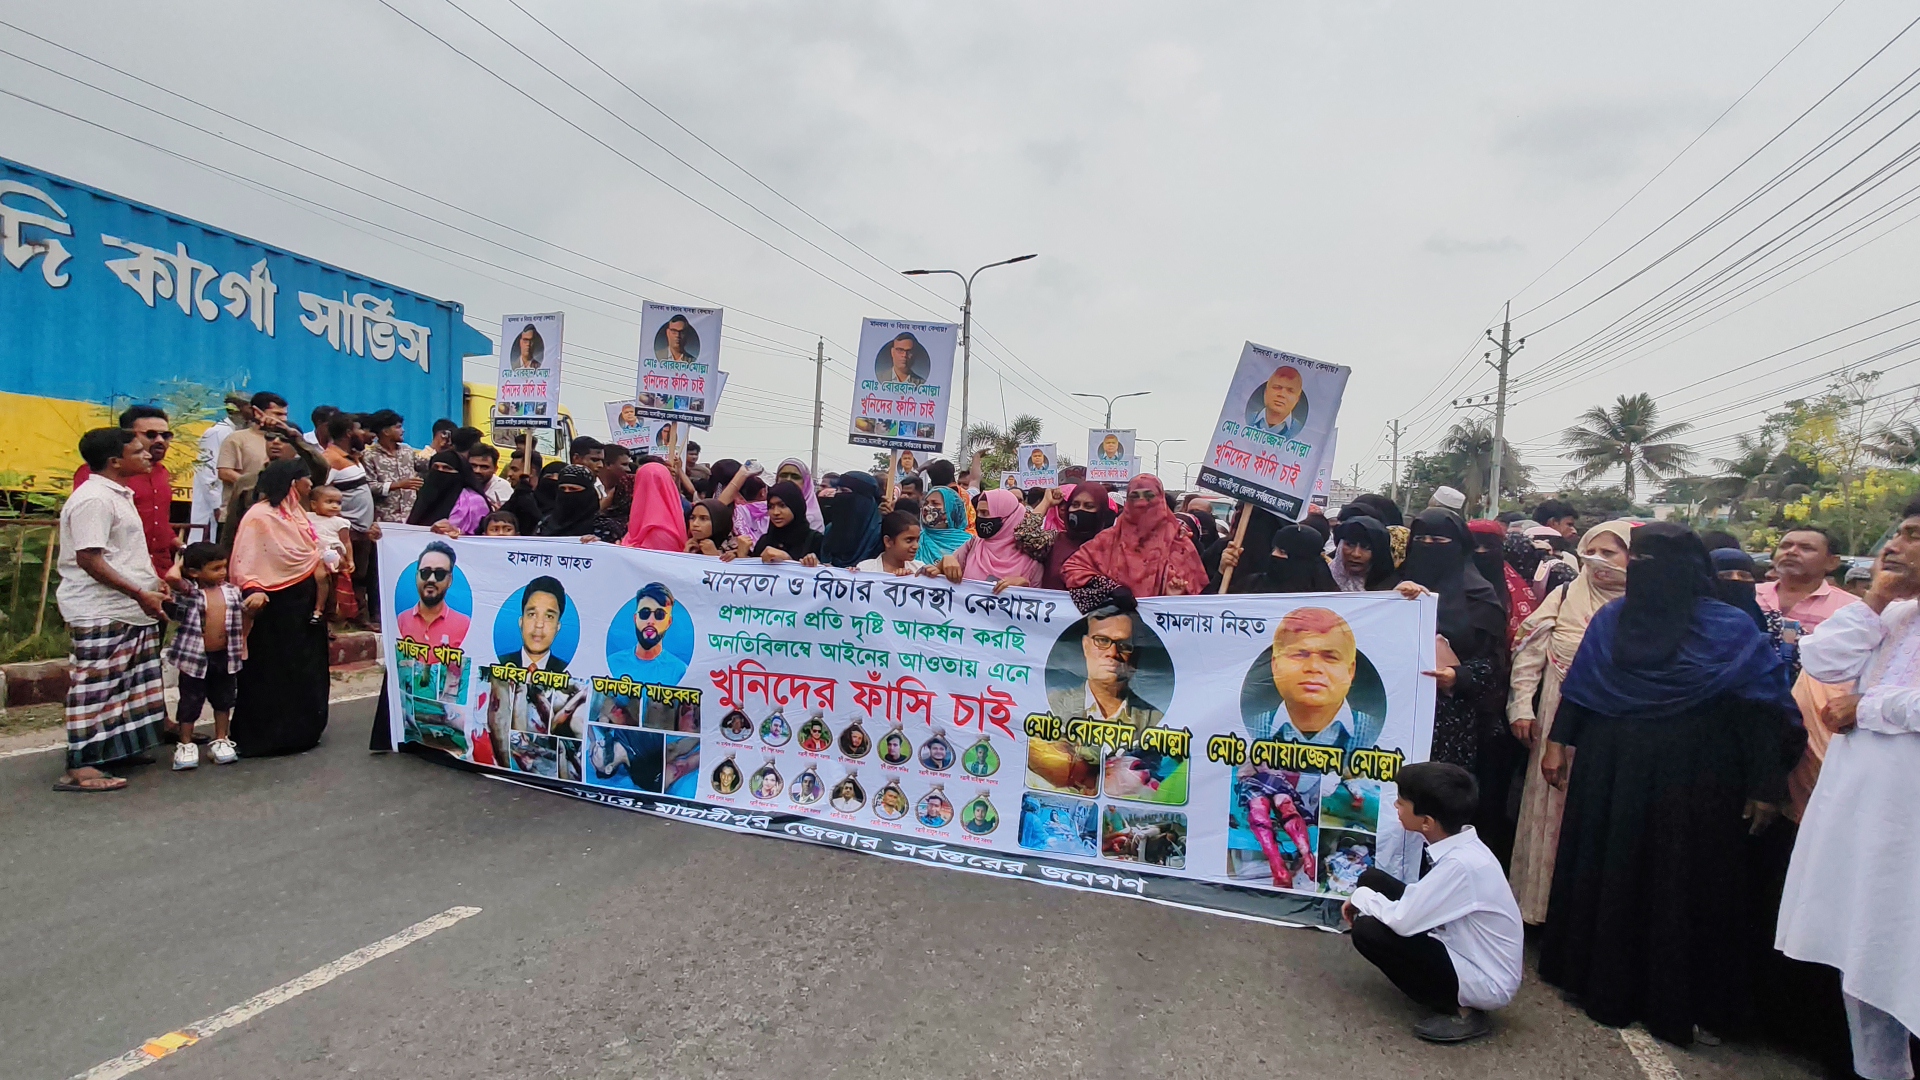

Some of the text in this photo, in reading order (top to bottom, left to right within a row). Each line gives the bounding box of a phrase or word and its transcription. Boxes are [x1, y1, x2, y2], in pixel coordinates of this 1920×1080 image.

[101, 233, 280, 338] কার্গো
[298, 288, 431, 373] সার্ভিস
[1280, 351, 1295, 364] বিচার
[691, 375, 705, 395] চাই
[861, 380, 941, 397] মোঃ বোরহান মোল্লা
[896, 395, 917, 418] ফাঁসি
[919, 399, 936, 421] চাই
[1221, 420, 1240, 436] মোঃ
[1286, 440, 1312, 458] মোল্লা
[1215, 440, 1301, 488] খুনিদের ফাঁসি চাই
[507, 550, 593, 572] হামলায় আহত
[702, 569, 780, 597] মানবতা
[788, 577, 804, 596] ও
[813, 569, 875, 603] বিচার
[882, 581, 956, 617] ব্যবস্থা
[719, 603, 1027, 653] প্রশাসনের প্রতি দৃষ্টি আকর্ষন করছি
[1154, 610, 1267, 636] হামলায় নিহত
[396, 637, 463, 666] সজিব খান
[708, 630, 1031, 684] অনতিবিলম্বে আইনের আওতায় এনে
[492, 664, 570, 689] জহির মোল্লা
[593, 676, 701, 706] তানভীর মাতুব্বর
[709, 658, 1018, 739] খুনিদের ফাঁসি চাই
[1025, 713, 1191, 758] মোঃ বোরহান মোল্লা
[1208, 734, 1402, 780] মোঃ মোয়াজ্জেম মোল্লা
[654, 801, 774, 829] মাদারীপুর
[783, 821, 882, 851] জেলার
[894, 841, 1026, 876] সর্বস্তরের
[1041, 864, 1148, 894] জনগণ
